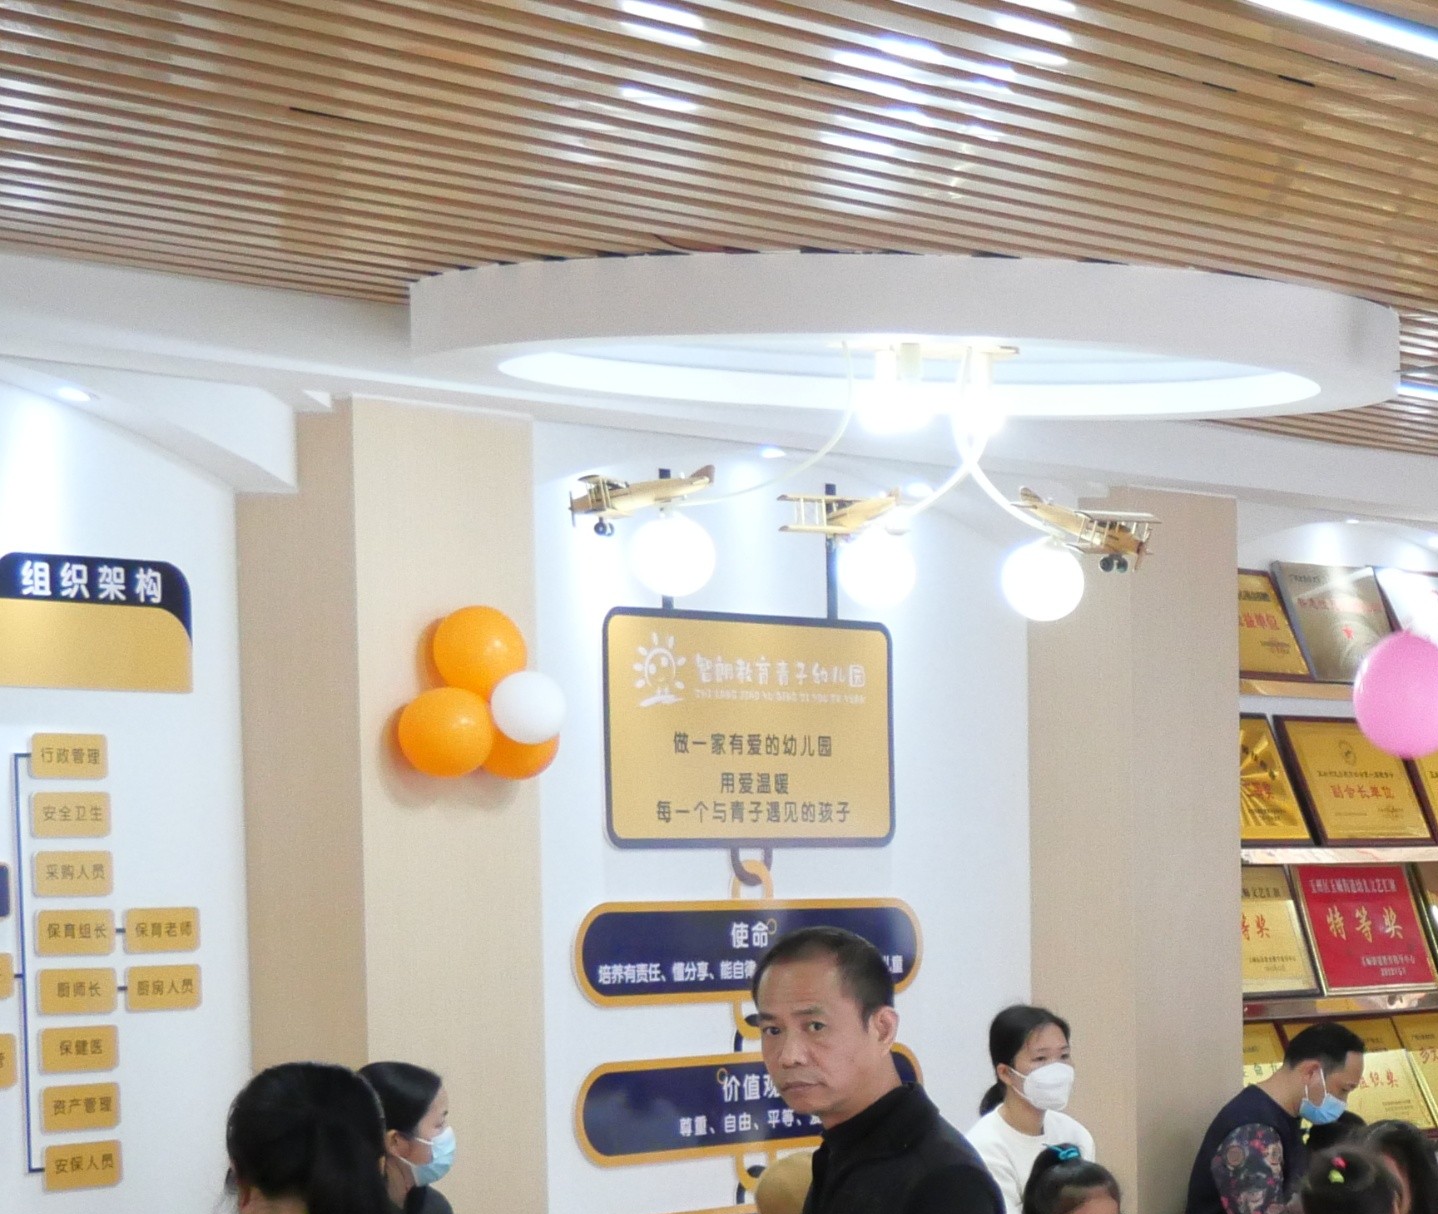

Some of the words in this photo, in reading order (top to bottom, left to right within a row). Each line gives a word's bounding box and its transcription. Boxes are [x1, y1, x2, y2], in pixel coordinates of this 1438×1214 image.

[21, 560, 162, 603] 组织架构
[673, 731, 833, 757] 做一家有爱的幼儿园
[40, 747, 101, 765] 行政管理
[720, 772, 789, 794] 用爱温暖
[42, 806, 103, 822] 安全卫生
[656, 800, 851, 823] 每一个与青子遇见的孩子
[45, 863, 106, 882] 采购人员
[47, 922, 107, 940] 保育组长
[135, 920, 194, 939] 保育老师
[1326, 905, 1404, 943] 特等奖
[731, 922, 769, 949] 使命
[57, 980, 101, 998] 厨师长
[137, 977, 195, 997] 厨房人员
[59, 1038, 103, 1057] 保健医
[54, 1153, 114, 1175] 安保人员
